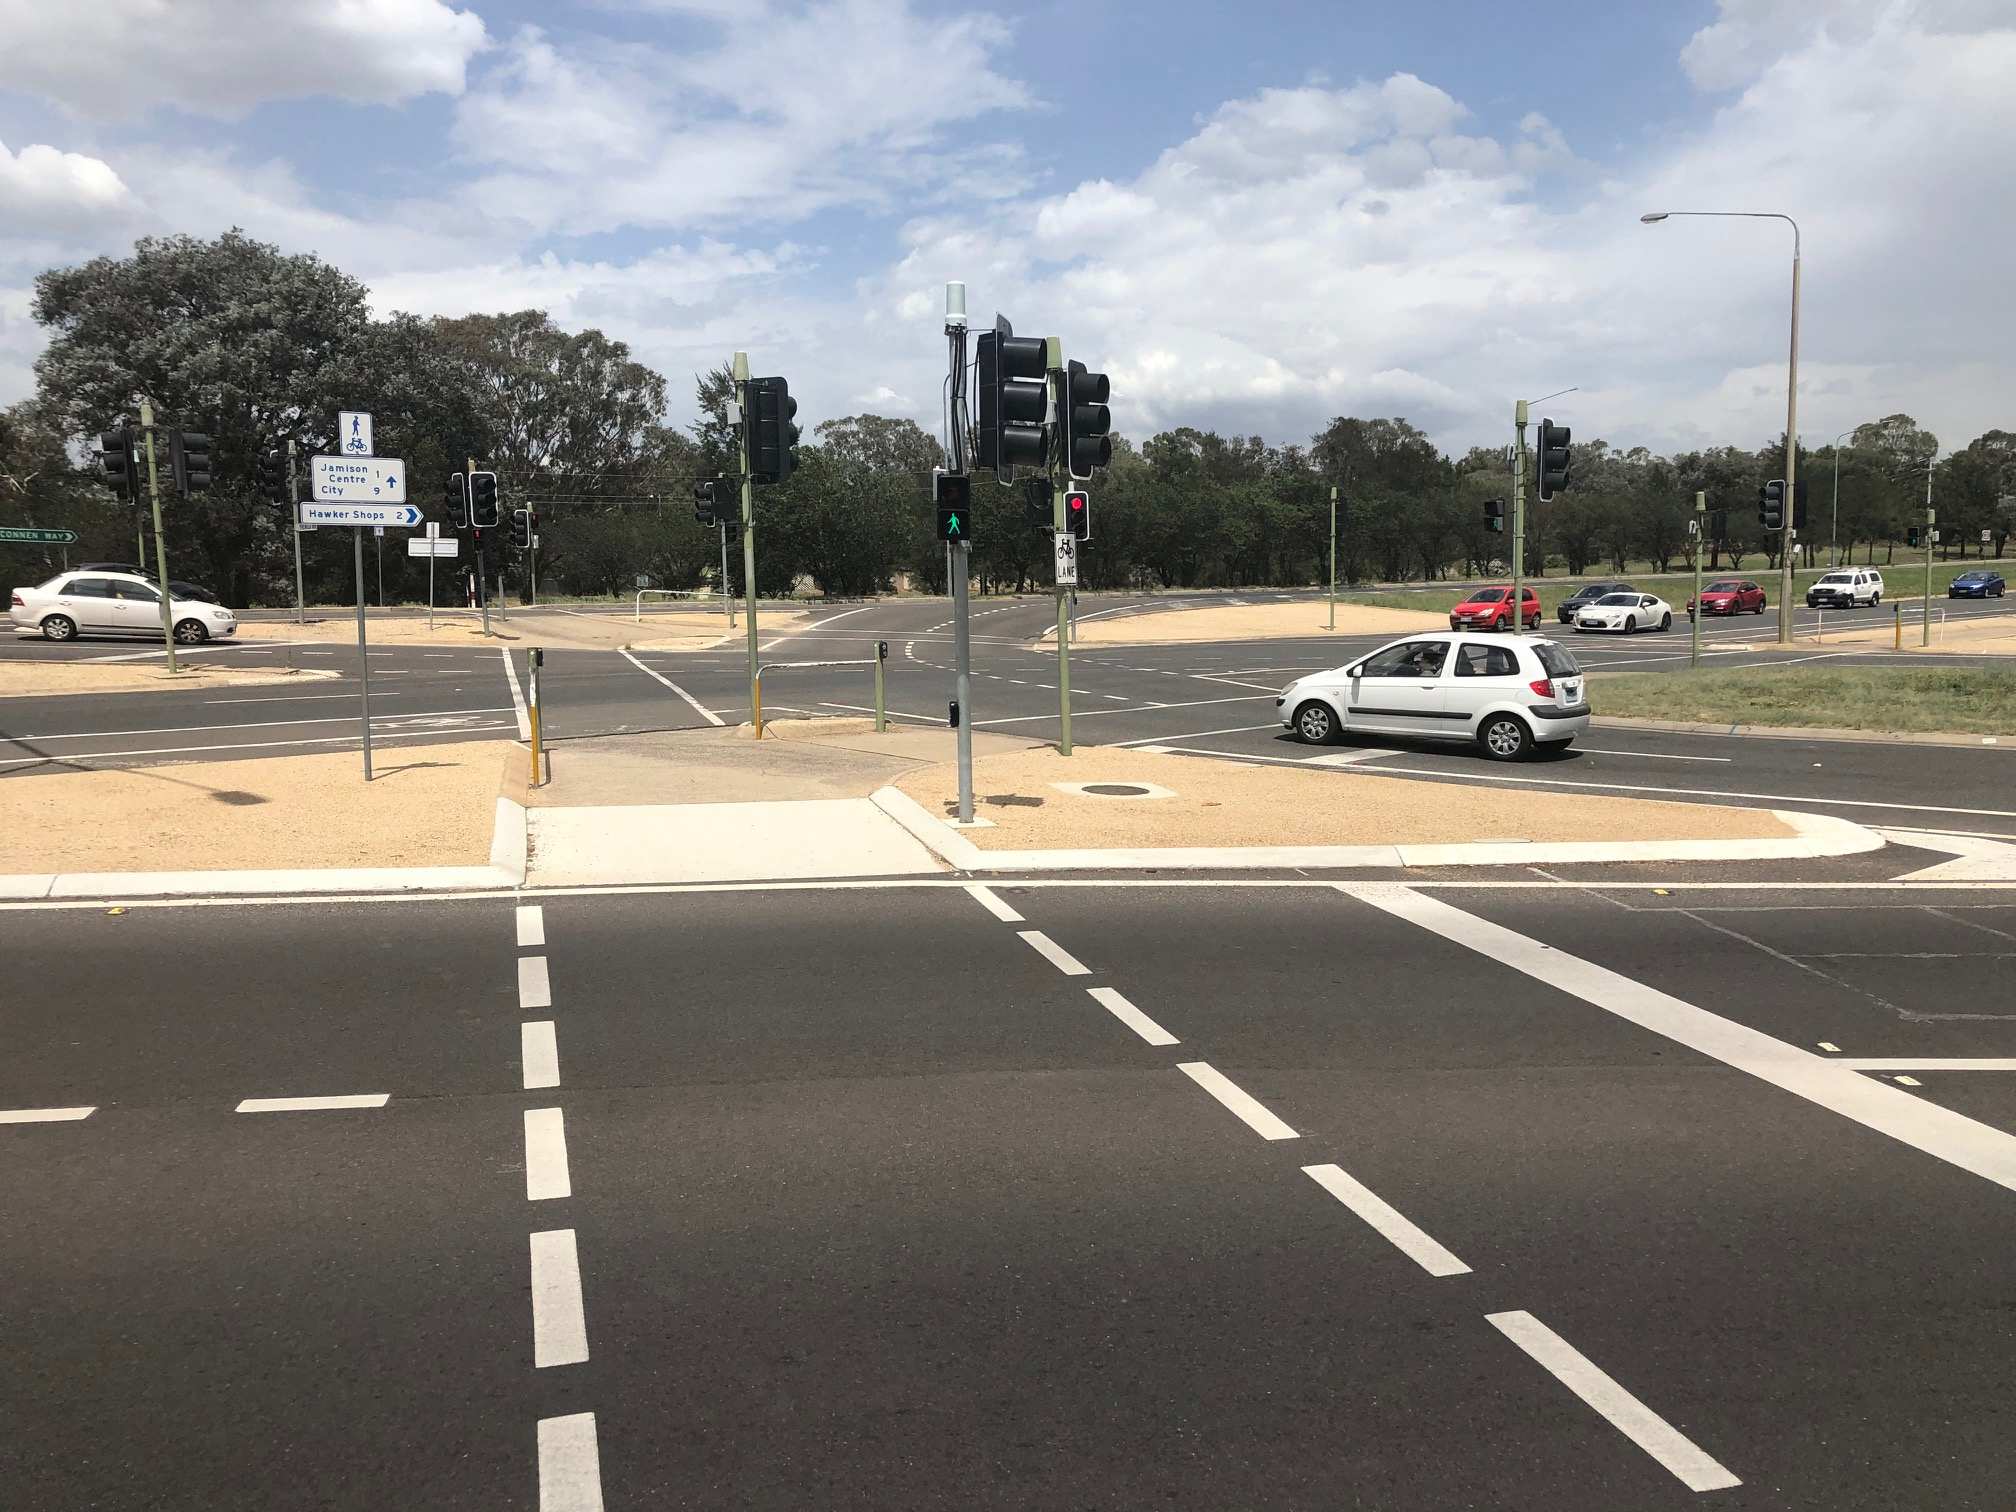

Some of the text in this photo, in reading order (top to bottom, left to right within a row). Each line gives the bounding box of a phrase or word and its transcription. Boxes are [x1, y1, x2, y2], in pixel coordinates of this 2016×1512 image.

[320, 464, 368, 473] Jamison
[329, 474, 366, 483] Centre
[376, 470, 380, 478] 1
[321, 486, 380, 496] City 9
[309, 509, 403, 520] Hawker Shops 2
[1058, 566, 1075, 578] LANE
